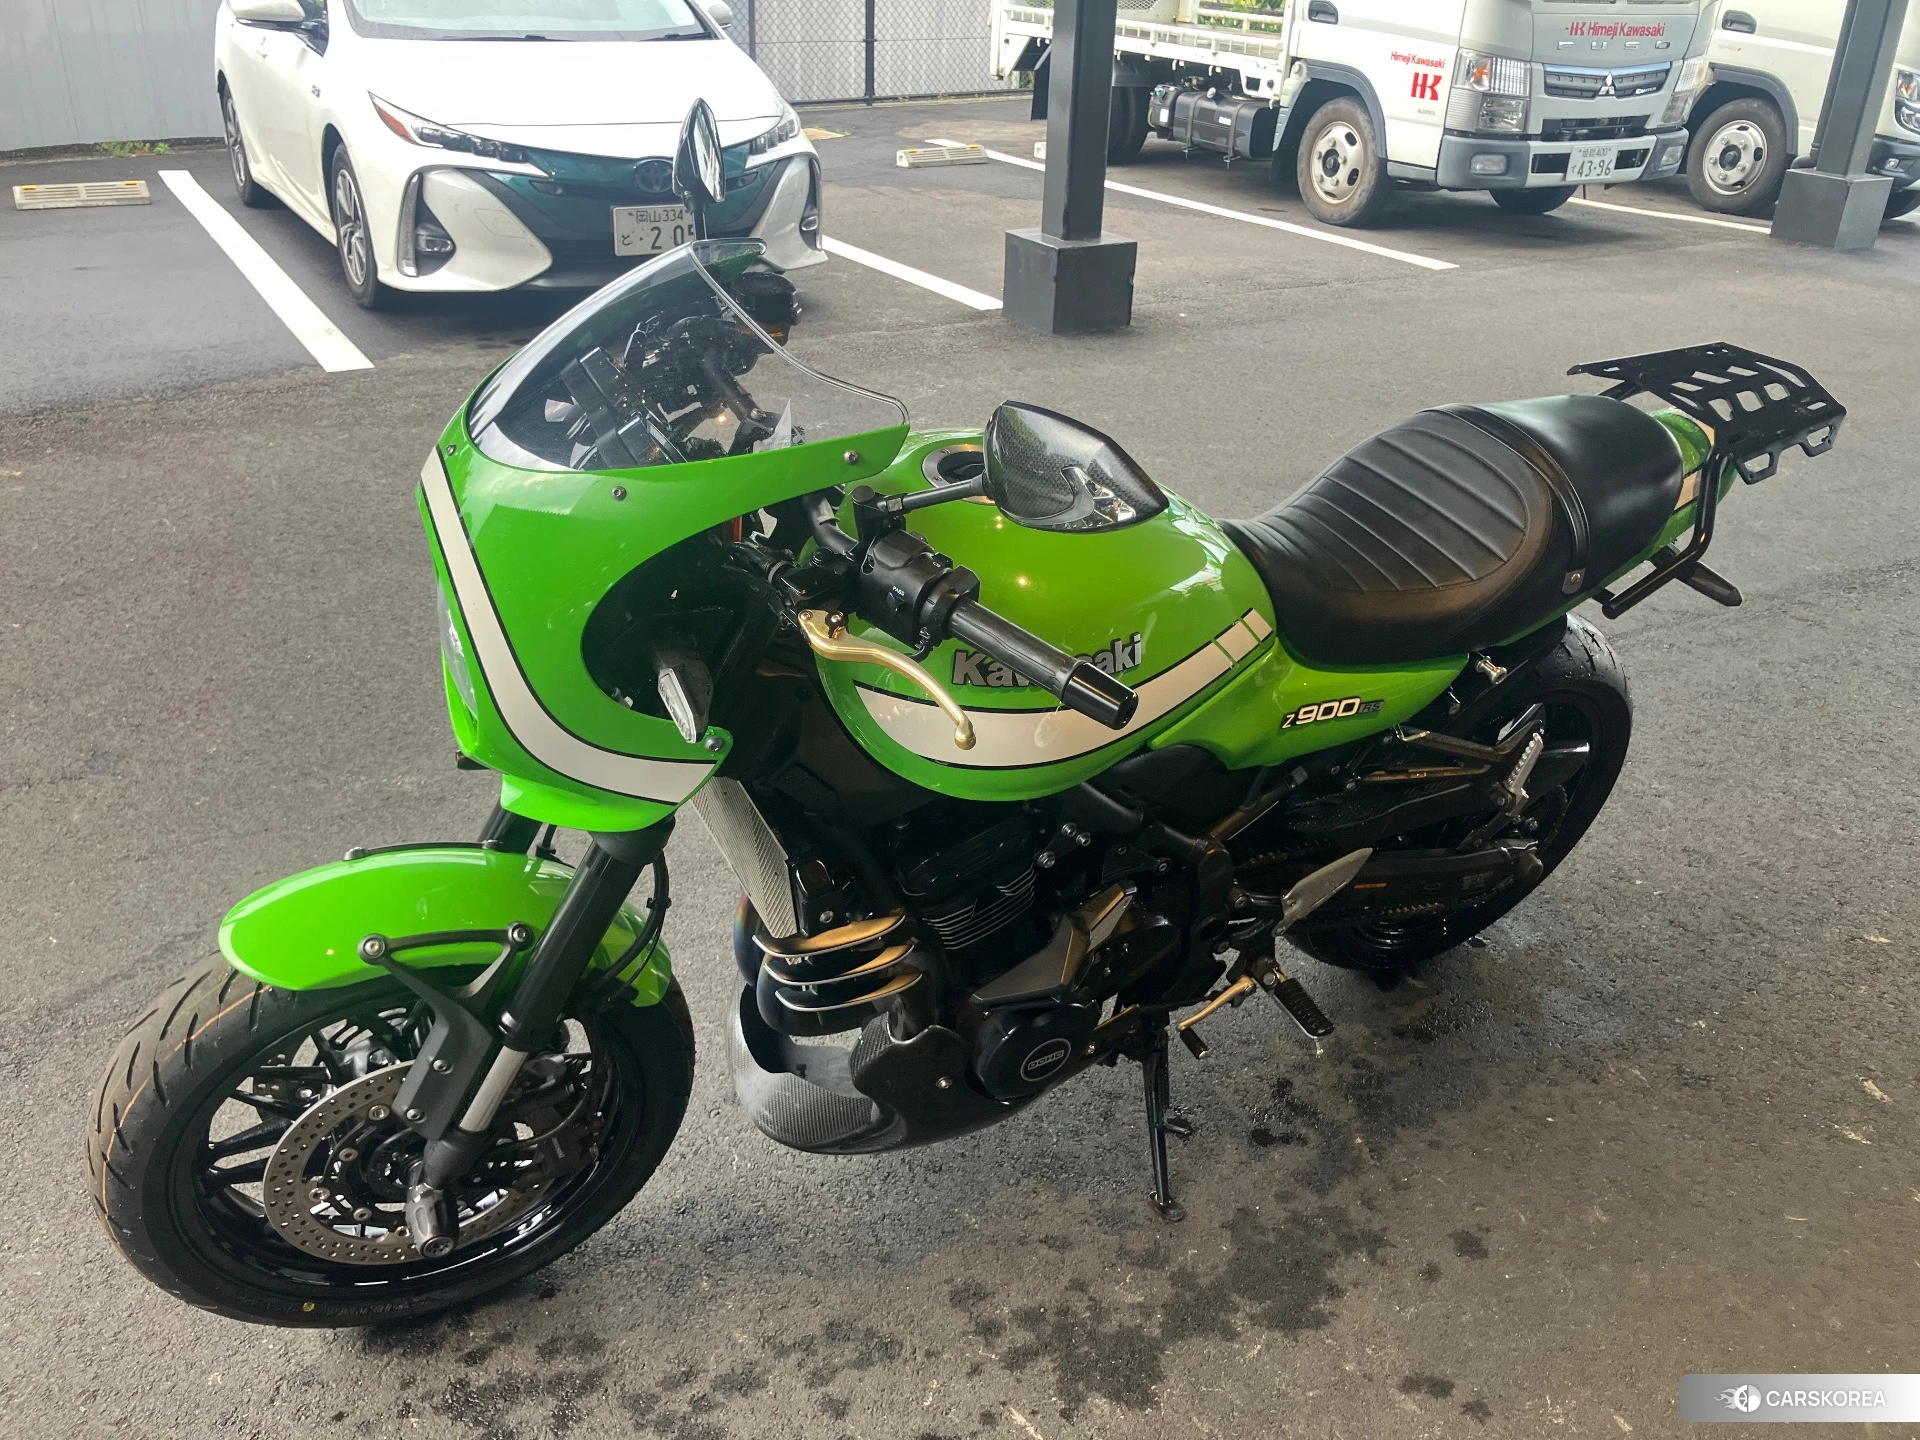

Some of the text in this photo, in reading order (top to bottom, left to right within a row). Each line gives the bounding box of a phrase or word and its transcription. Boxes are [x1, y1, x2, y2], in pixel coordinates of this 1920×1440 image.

[1587, 22, 1619, 40] Himeji
[1619, 22, 1666, 37] Kawasaki
[1557, 41, 1671, 50] FUSO
[1390, 51, 1446, 69] Himeji Kawasaki
[1028, 1050, 1065, 1070] DOHC
